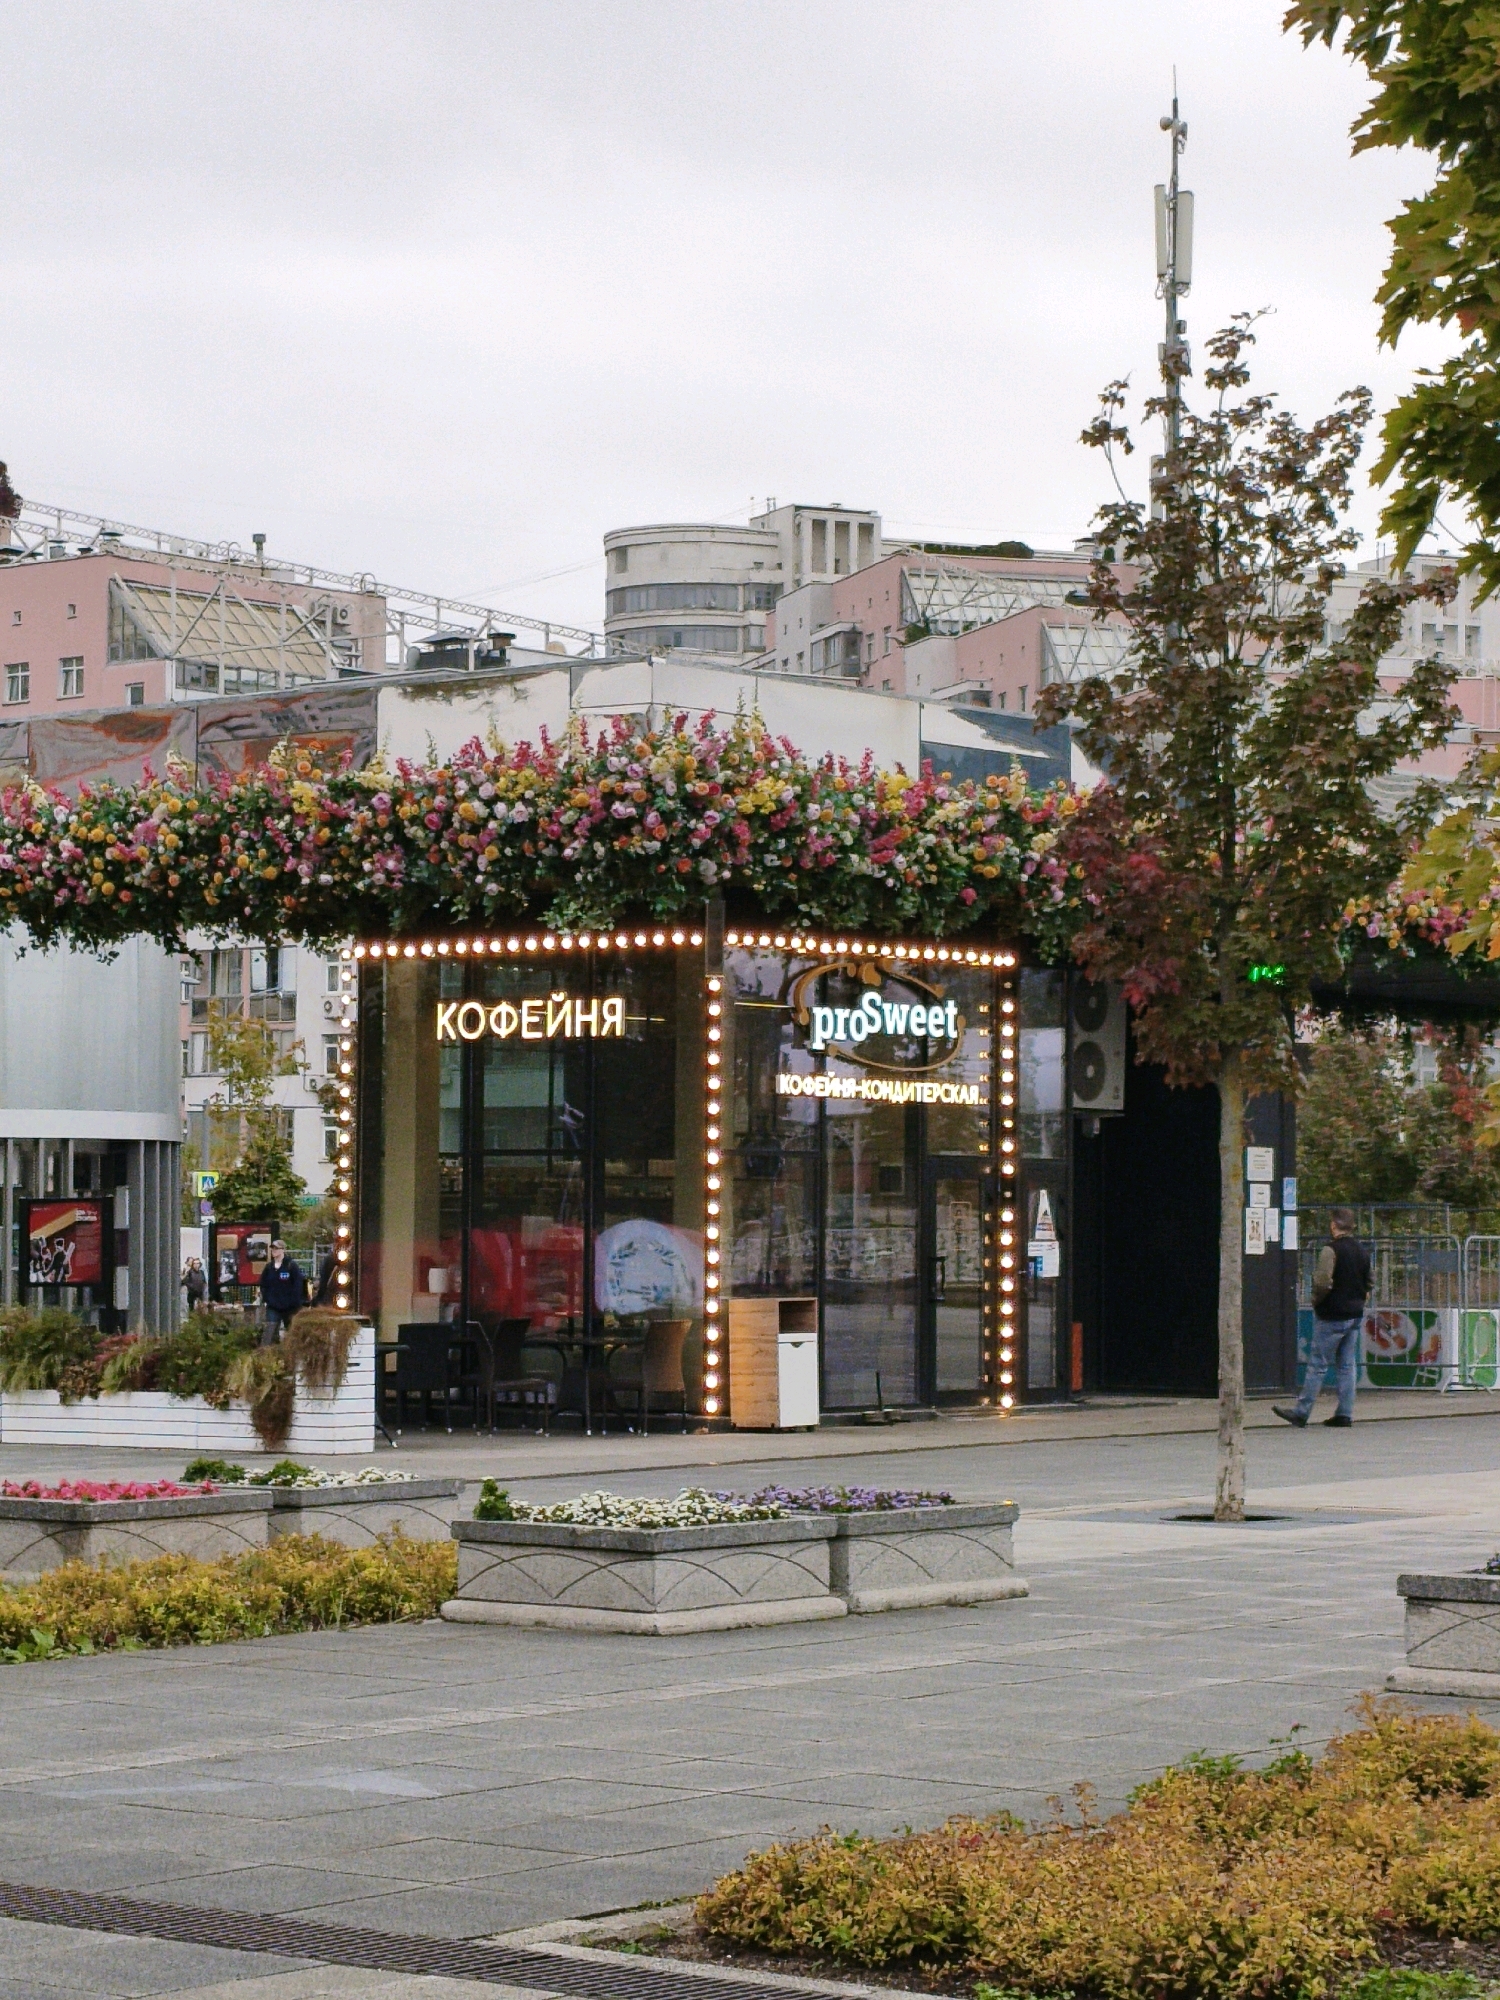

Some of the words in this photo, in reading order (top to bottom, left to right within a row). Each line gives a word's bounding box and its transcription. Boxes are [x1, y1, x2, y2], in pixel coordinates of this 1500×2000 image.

[435, 991, 626, 1042] КОФЕЙНЯ
[810, 991, 958, 1050] proSweet
[777, 1072, 980, 1105] КОФЕЙНЯ-КОНДИТЕРСКАЯ
